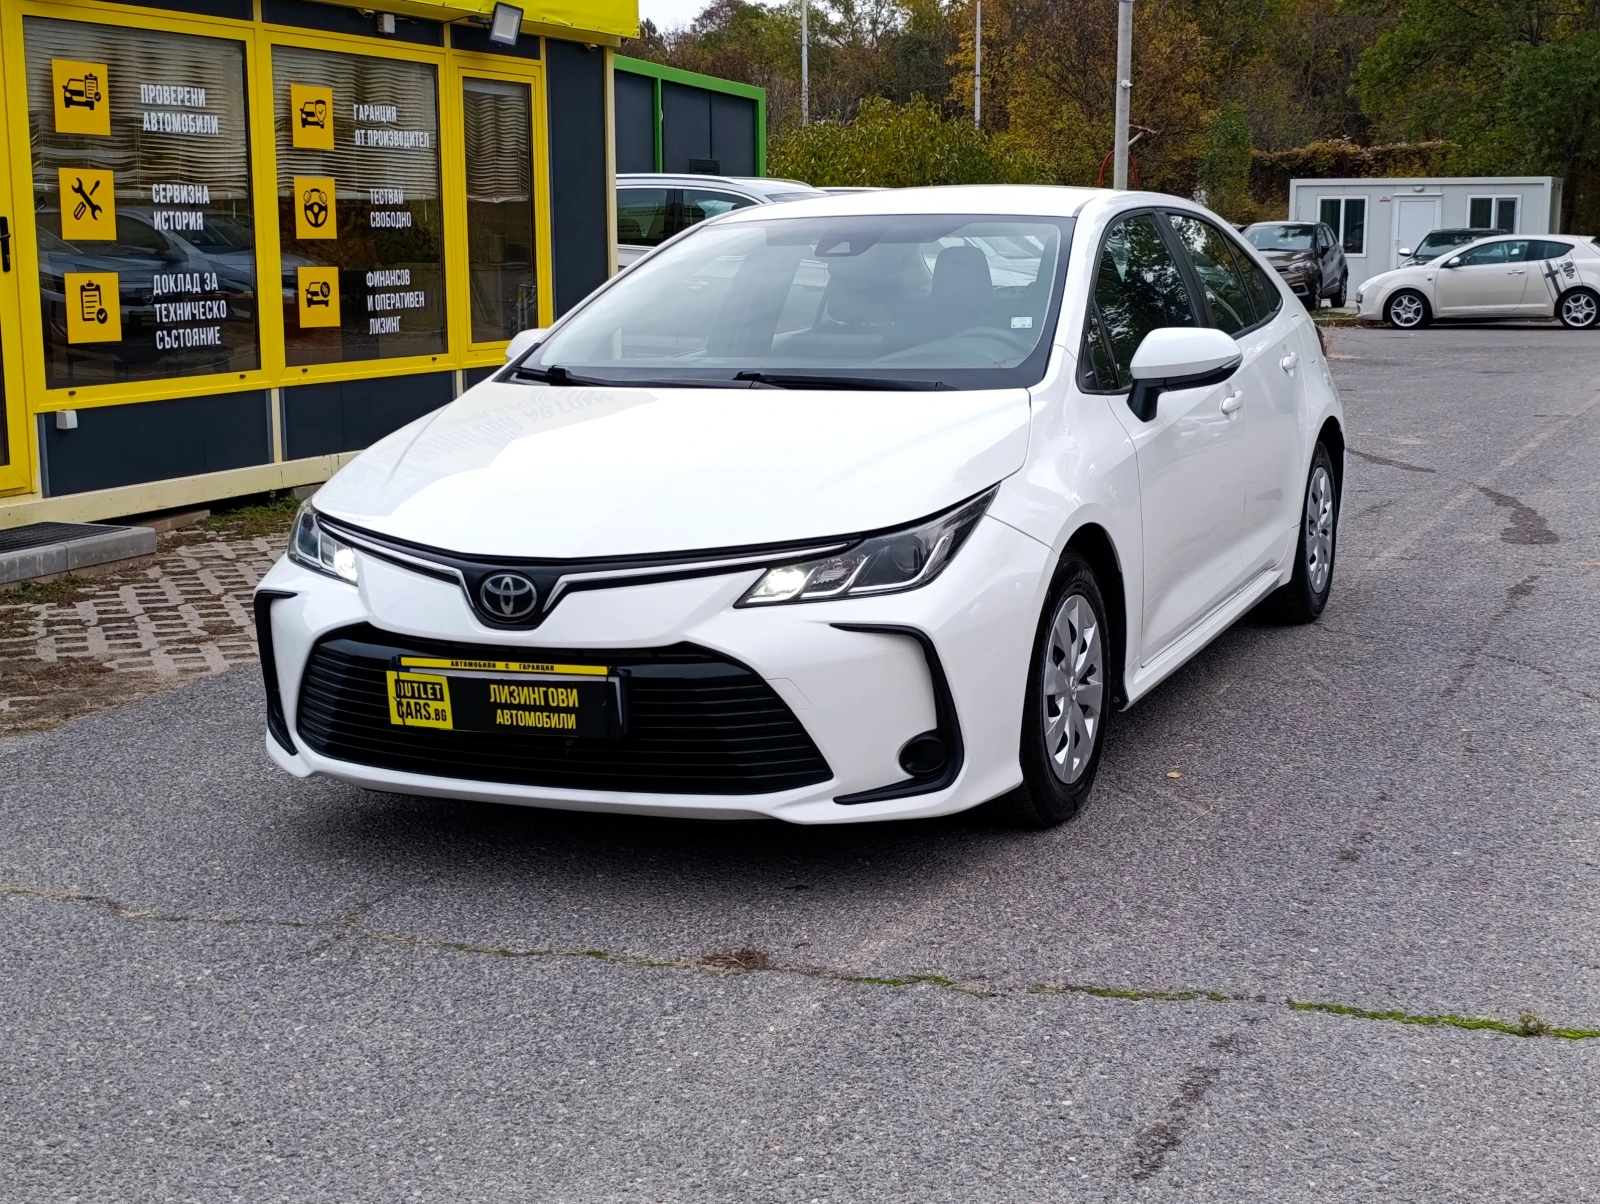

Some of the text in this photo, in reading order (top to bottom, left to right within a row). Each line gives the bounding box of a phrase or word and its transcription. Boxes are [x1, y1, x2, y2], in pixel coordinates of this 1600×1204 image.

[140, 83, 206, 107] ПРОВЕРЕНИ
[143, 112, 218, 134] АВТОМОБИЛИ
[353, 104, 396, 123] ГАРАНЦИЯ
[355, 130, 430, 149] ОТ ПРОИЗВОДИТЕЛ
[152, 184, 210, 205] СЕРВИЗНА
[370, 187, 404, 205] ТЕСТВАЙ
[153, 211, 204, 231] ИСТОРИЯ
[370, 212, 412, 229] СВОБОДНО
[153, 273, 219, 296] ДОКЛАД ЗА
[366, 269, 411, 288] ФИНАНСОВ
[154, 300, 227, 323] ТЕХНИЧЕСКО
[367, 291, 425, 312] И ОПЕРАТИВЕН
[369, 316, 401, 335] ЛИЗИНГ
[156, 326, 222, 350] СЪСТОЯНИЕ
[450, 660, 497, 669] АВТОМОБИЛИ
[518, 663, 555, 671] ГАРАНЦИЯ
[397, 681, 441, 700] OUTLET
[489, 684, 579, 708] ЛИЗИНГОВИ
[496, 709, 577, 729] АВТОМОБИЛИ
